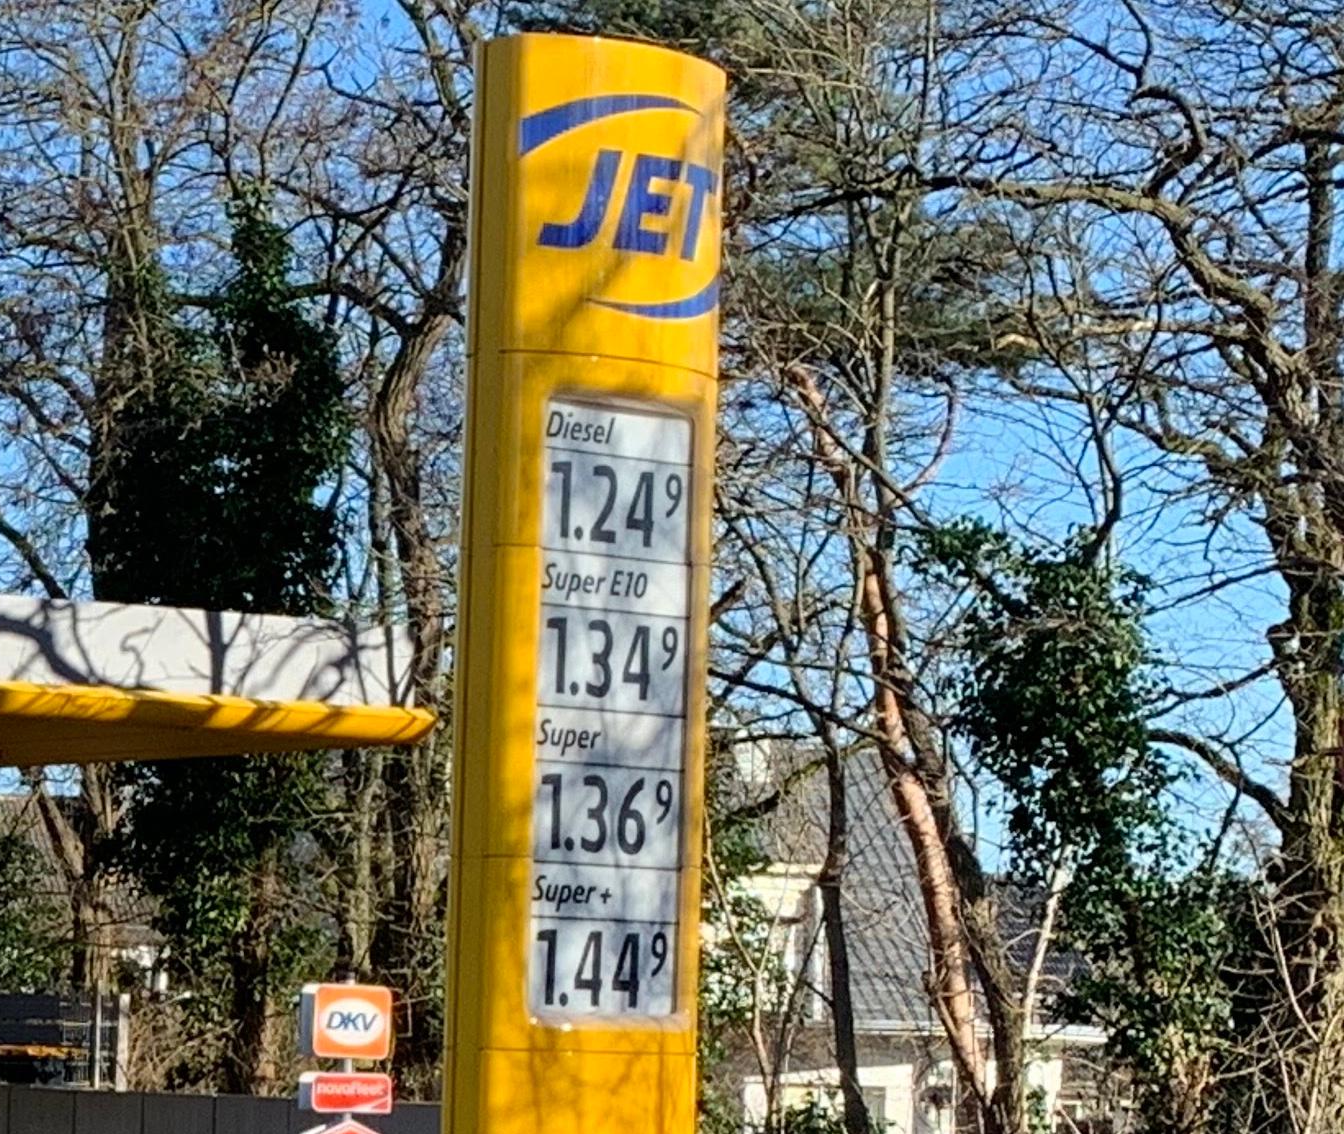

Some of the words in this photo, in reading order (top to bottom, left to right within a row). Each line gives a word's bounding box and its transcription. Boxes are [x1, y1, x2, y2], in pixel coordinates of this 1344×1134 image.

[536, 149, 720, 262] JET
[545, 411, 616, 444] Diesel
[541, 562, 606, 600] Super
[609, 570, 648, 599] E10
[536, 718, 602, 757] Super
[531, 875, 596, 912] Super
[325, 1010, 379, 1032] DKV
